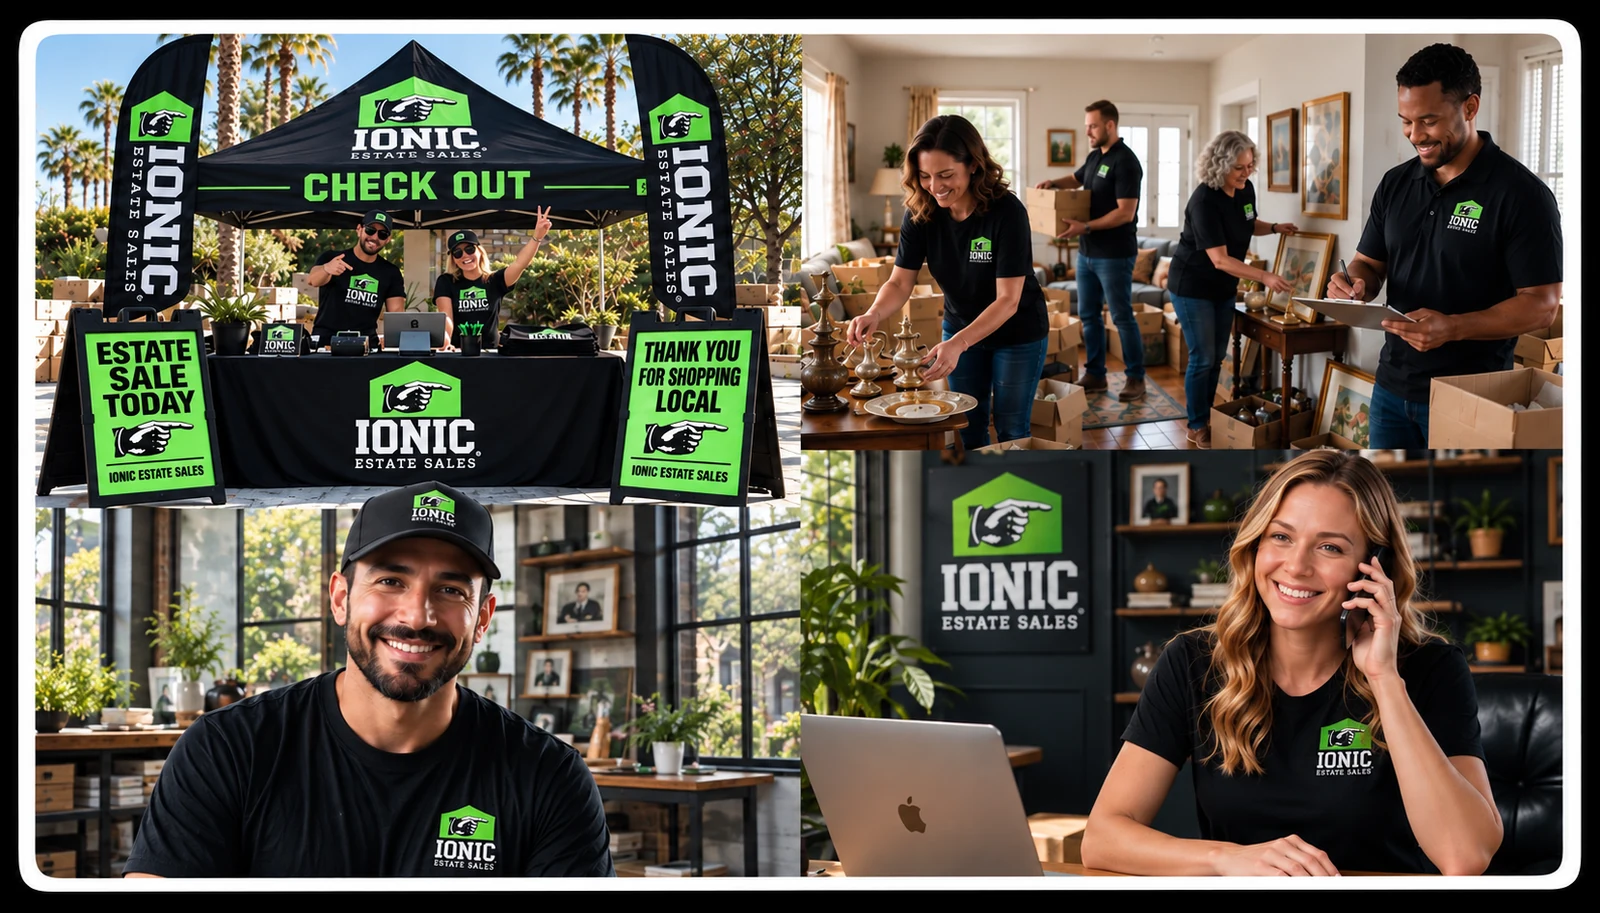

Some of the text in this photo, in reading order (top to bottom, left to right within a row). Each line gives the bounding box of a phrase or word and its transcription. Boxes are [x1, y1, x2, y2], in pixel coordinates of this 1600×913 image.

[351, 128, 480, 151] IONIC
[350, 152, 418, 160] ESTATE
[304, 170, 531, 201] CHECK OUT
[125, 146, 144, 292] ESTATE SALES
[141, 145, 185, 296] IONIC
[672, 145, 718, 296] IONIC
[1449, 215, 1479, 230] IONIC
[664, 231, 677, 294] SALES
[346, 288, 378, 303] IONIC
[458, 298, 489, 308] IONIC
[96, 339, 192, 365] ESTATE
[645, 340, 741, 362] THANK YOU
[110, 364, 188, 392] SALE
[638, 367, 741, 386] FOR SHOPPING
[103, 390, 195, 418] TODAY
[656, 390, 721, 413] LOCAL
[356, 419, 475, 454] IONIC
[109, 465, 204, 483] IONIC ESTATE SALES
[355, 458, 476, 468] ESTATE SALES
[632, 465, 728, 482] IONIC ESTATE SALES
[412, 508, 454, 522] IONIC
[941, 560, 1078, 611] IONIC
[942, 615, 1078, 630] ESTATE SALES
[1316, 750, 1372, 768] IONIC
[434, 840, 496, 862] IONIC
[434, 860, 494, 870] ESTATE SALES
